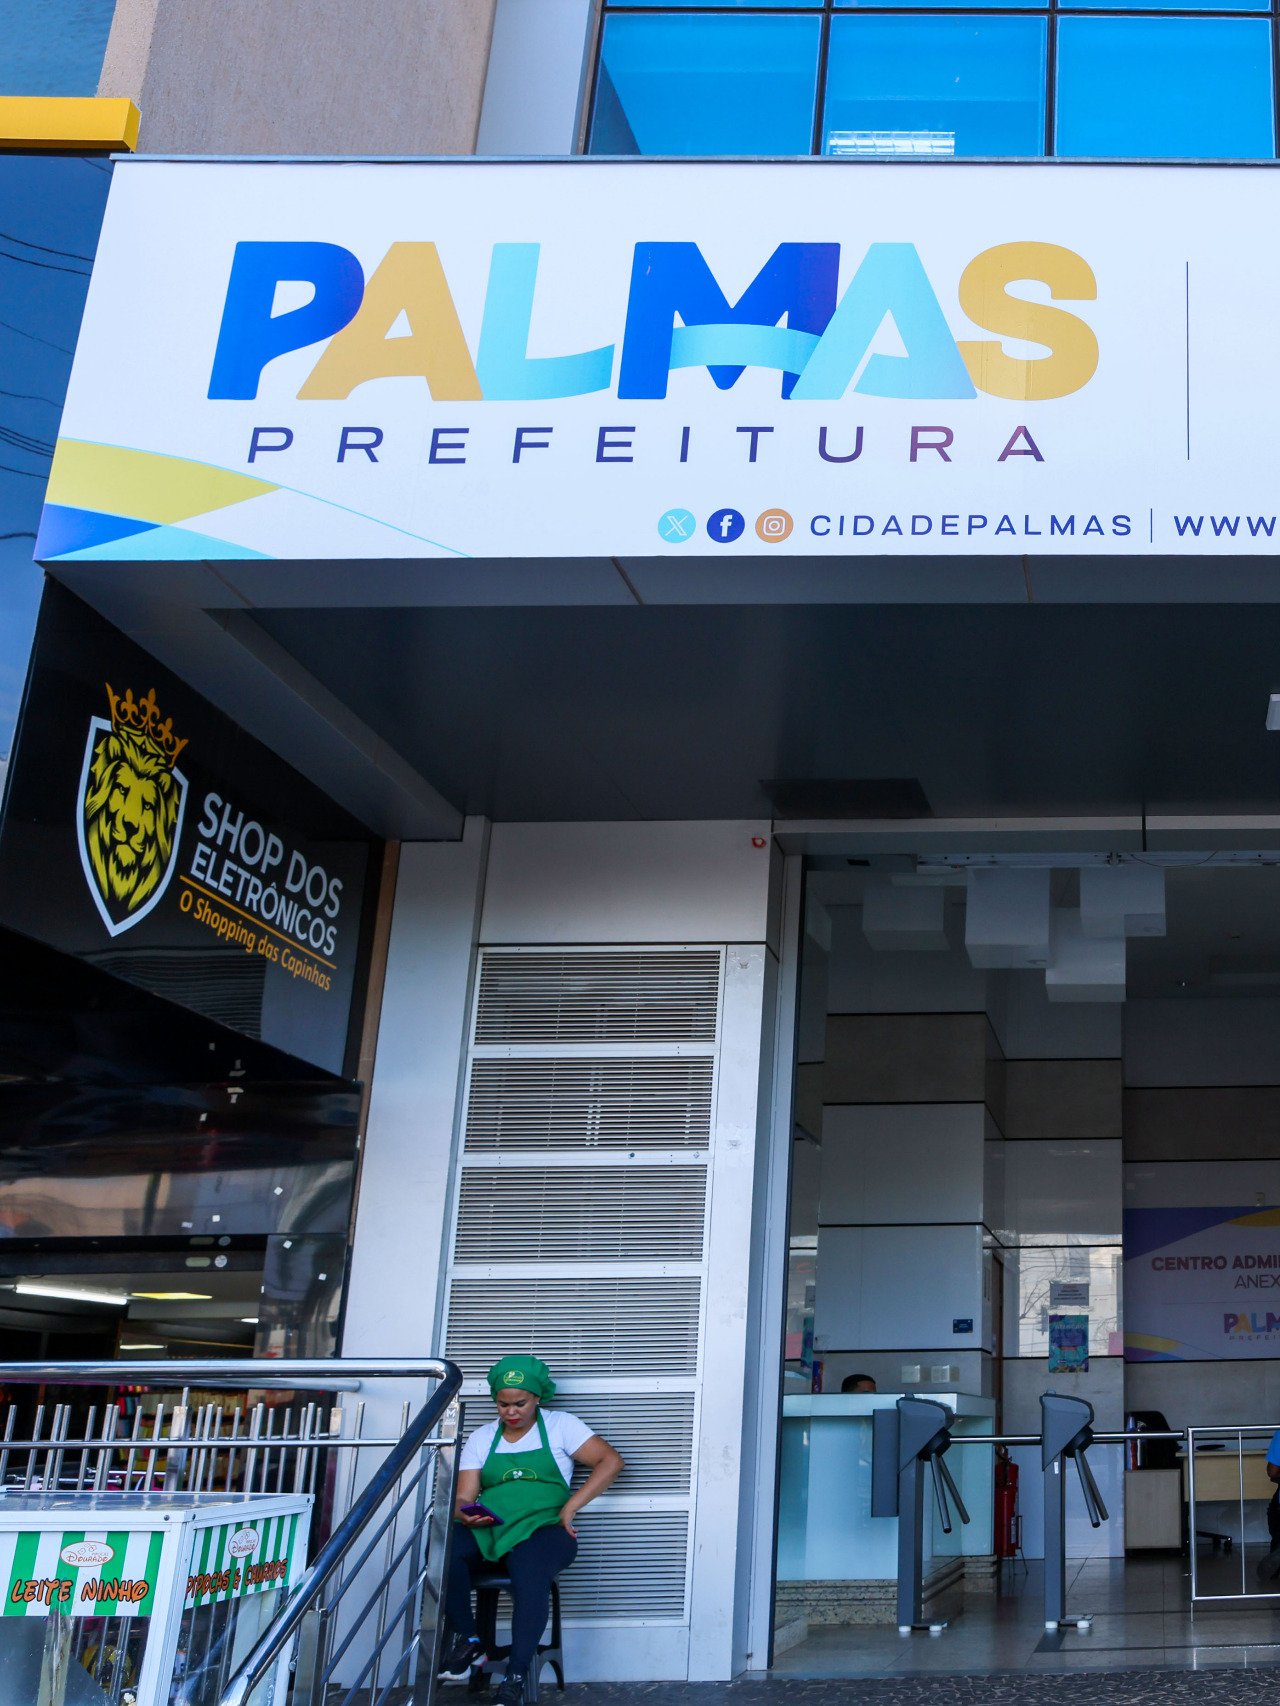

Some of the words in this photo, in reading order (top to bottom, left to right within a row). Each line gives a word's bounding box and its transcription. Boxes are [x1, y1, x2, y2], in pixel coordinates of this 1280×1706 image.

[206, 240, 1099, 401] PALMAS
[247, 426, 1046, 465] PREFEITURA
[809, 514, 1133, 538] CIDADEPALMAS
[198, 792, 283, 874] SHOP
[285, 850, 343, 918] DOS
[190, 841, 338, 957] ELETRÔNICOS
[179, 889, 193, 912] O
[193, 899, 255, 954] Shopping
[257, 934, 278, 962] das
[281, 948, 331, 991] Capinhas
[1151, 1256, 1227, 1271] CENTRO
[11, 1578, 73, 1605] LEITE
[81, 1577, 149, 1603] NINHO
[186, 1571, 229, 1600] PIPOCAS
[233, 1568, 241, 1591] &
[245, 1559, 288, 1586] CHURROS
